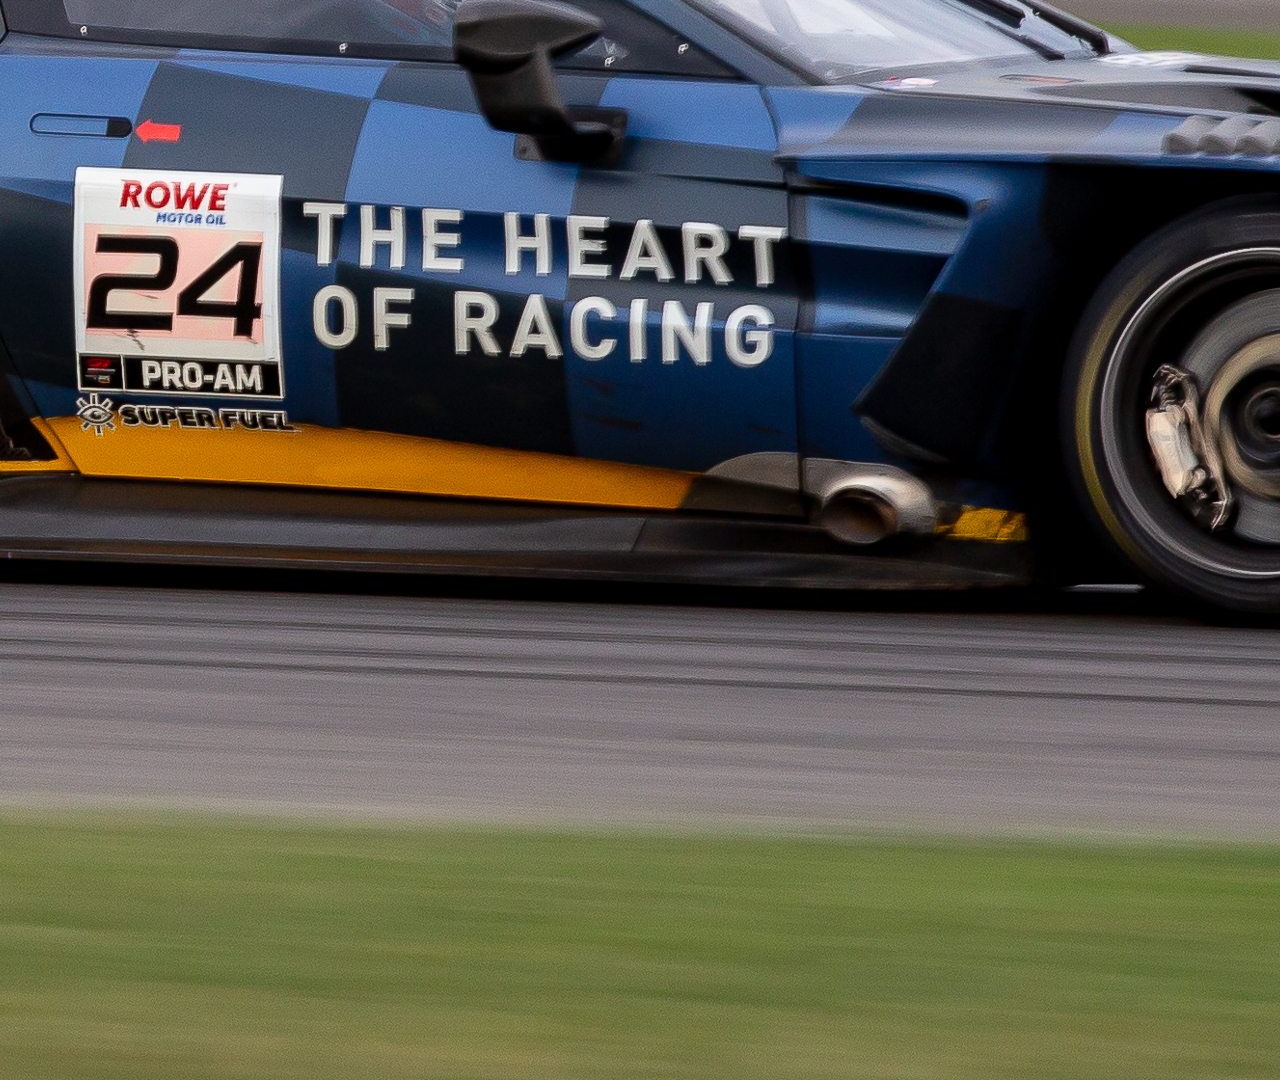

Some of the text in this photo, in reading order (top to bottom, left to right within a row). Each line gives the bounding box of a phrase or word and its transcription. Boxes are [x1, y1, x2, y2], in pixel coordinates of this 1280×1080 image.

[119, 178, 230, 212] ROWE
[155, 211, 227, 226] MOTOR OIL
[302, 201, 789, 288] THE HEART
[86, 233, 263, 337] 24
[311, 283, 776, 369] OF RACING
[140, 359, 263, 393] PRO-AM
[118, 404, 302, 433] SUPER FUEL
